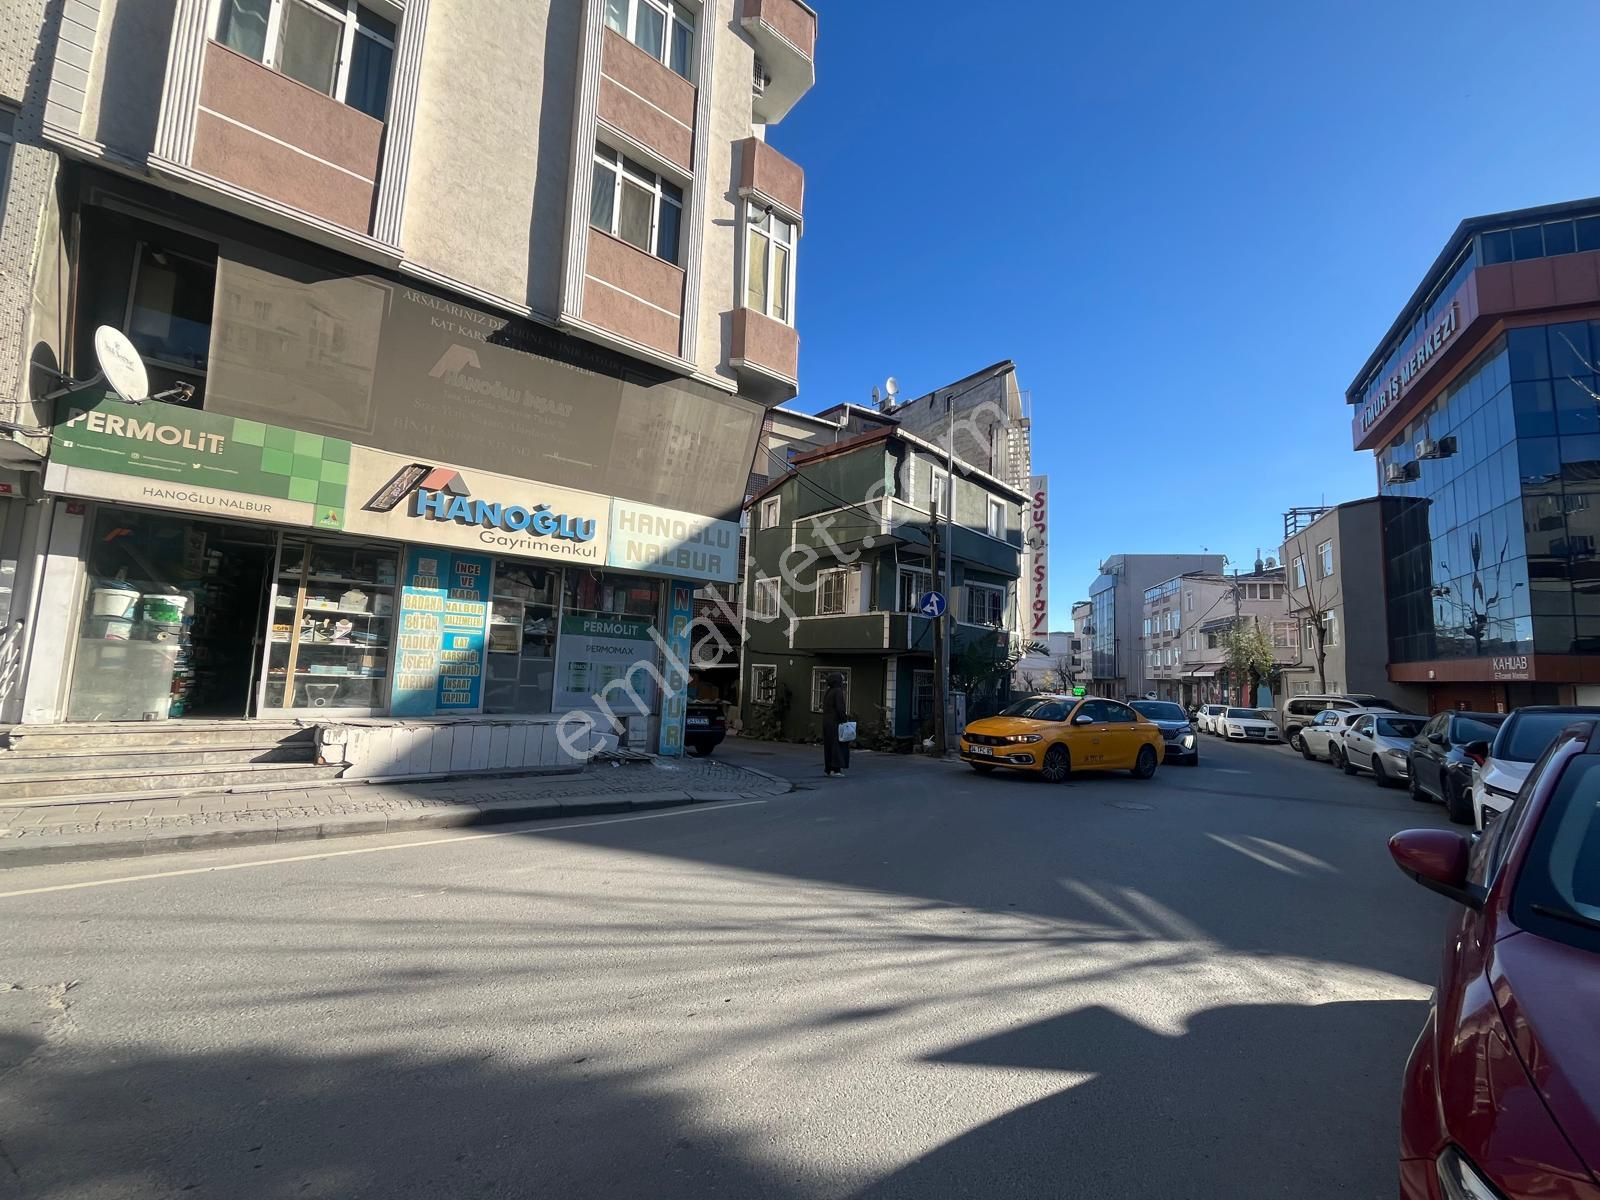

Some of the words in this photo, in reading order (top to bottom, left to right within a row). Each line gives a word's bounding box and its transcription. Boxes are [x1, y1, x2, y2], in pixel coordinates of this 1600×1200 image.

[401, 288, 487, 325] ARSALARINIZ
[428, 316, 455, 332] KAT
[1401, 301, 1458, 385] MERKEZİ
[143, 486, 216, 507] HANOĞLU
[219, 494, 272, 513] NALBUR
[416, 487, 597, 542] HANOĞLU
[618, 509, 731, 549] HANOĞLU
[479, 530, 598, 558] Gayrimenkul
[626, 540, 722, 575] NALBUR
[456, 562, 480, 575] İNCE
[413, 575, 438, 591] BOYA
[461, 576, 473, 587] VE
[404, 595, 442, 610] BADANA
[406, 614, 438, 631] BÜTÜN
[455, 637, 469, 647] KAT
[586, 643, 635, 656] PERMOMAX
[442, 691, 471, 705] YAPILIR
